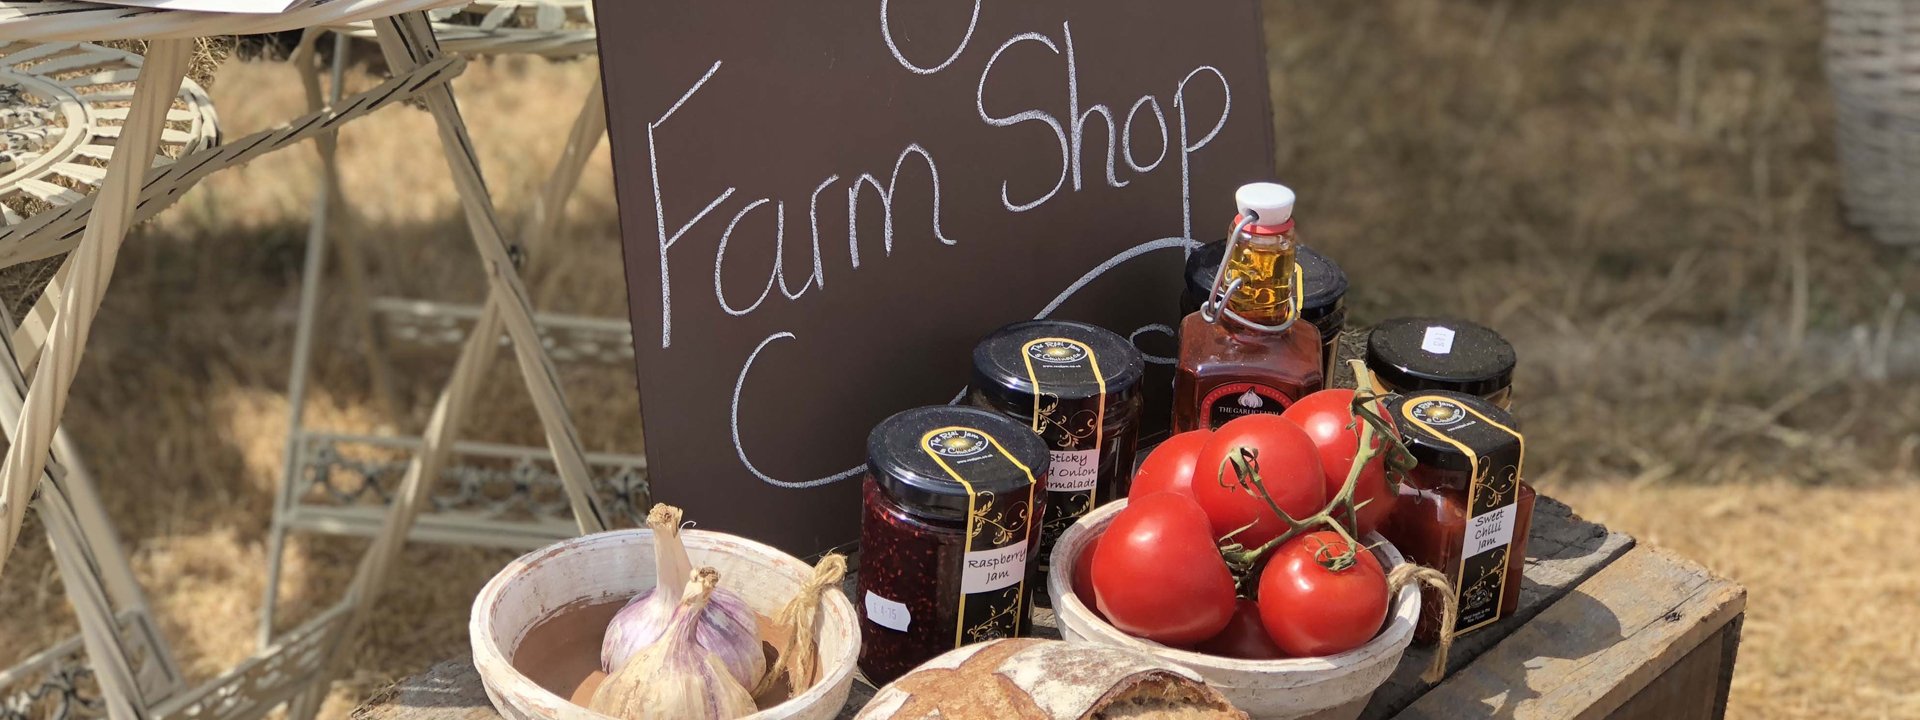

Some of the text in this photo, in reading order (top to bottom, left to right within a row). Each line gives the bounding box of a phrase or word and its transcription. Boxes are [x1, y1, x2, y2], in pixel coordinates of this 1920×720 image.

[647, 21, 1231, 348] Farm Shop
[1219, 406, 1232, 414] THE
[1050, 452, 1087, 467] Sticky
[1059, 466, 1096, 477] Onion
[1047, 479, 1095, 489] rmalade
[1475, 508, 1504, 527] Sweet
[968, 547, 1026, 570] Raspberry
